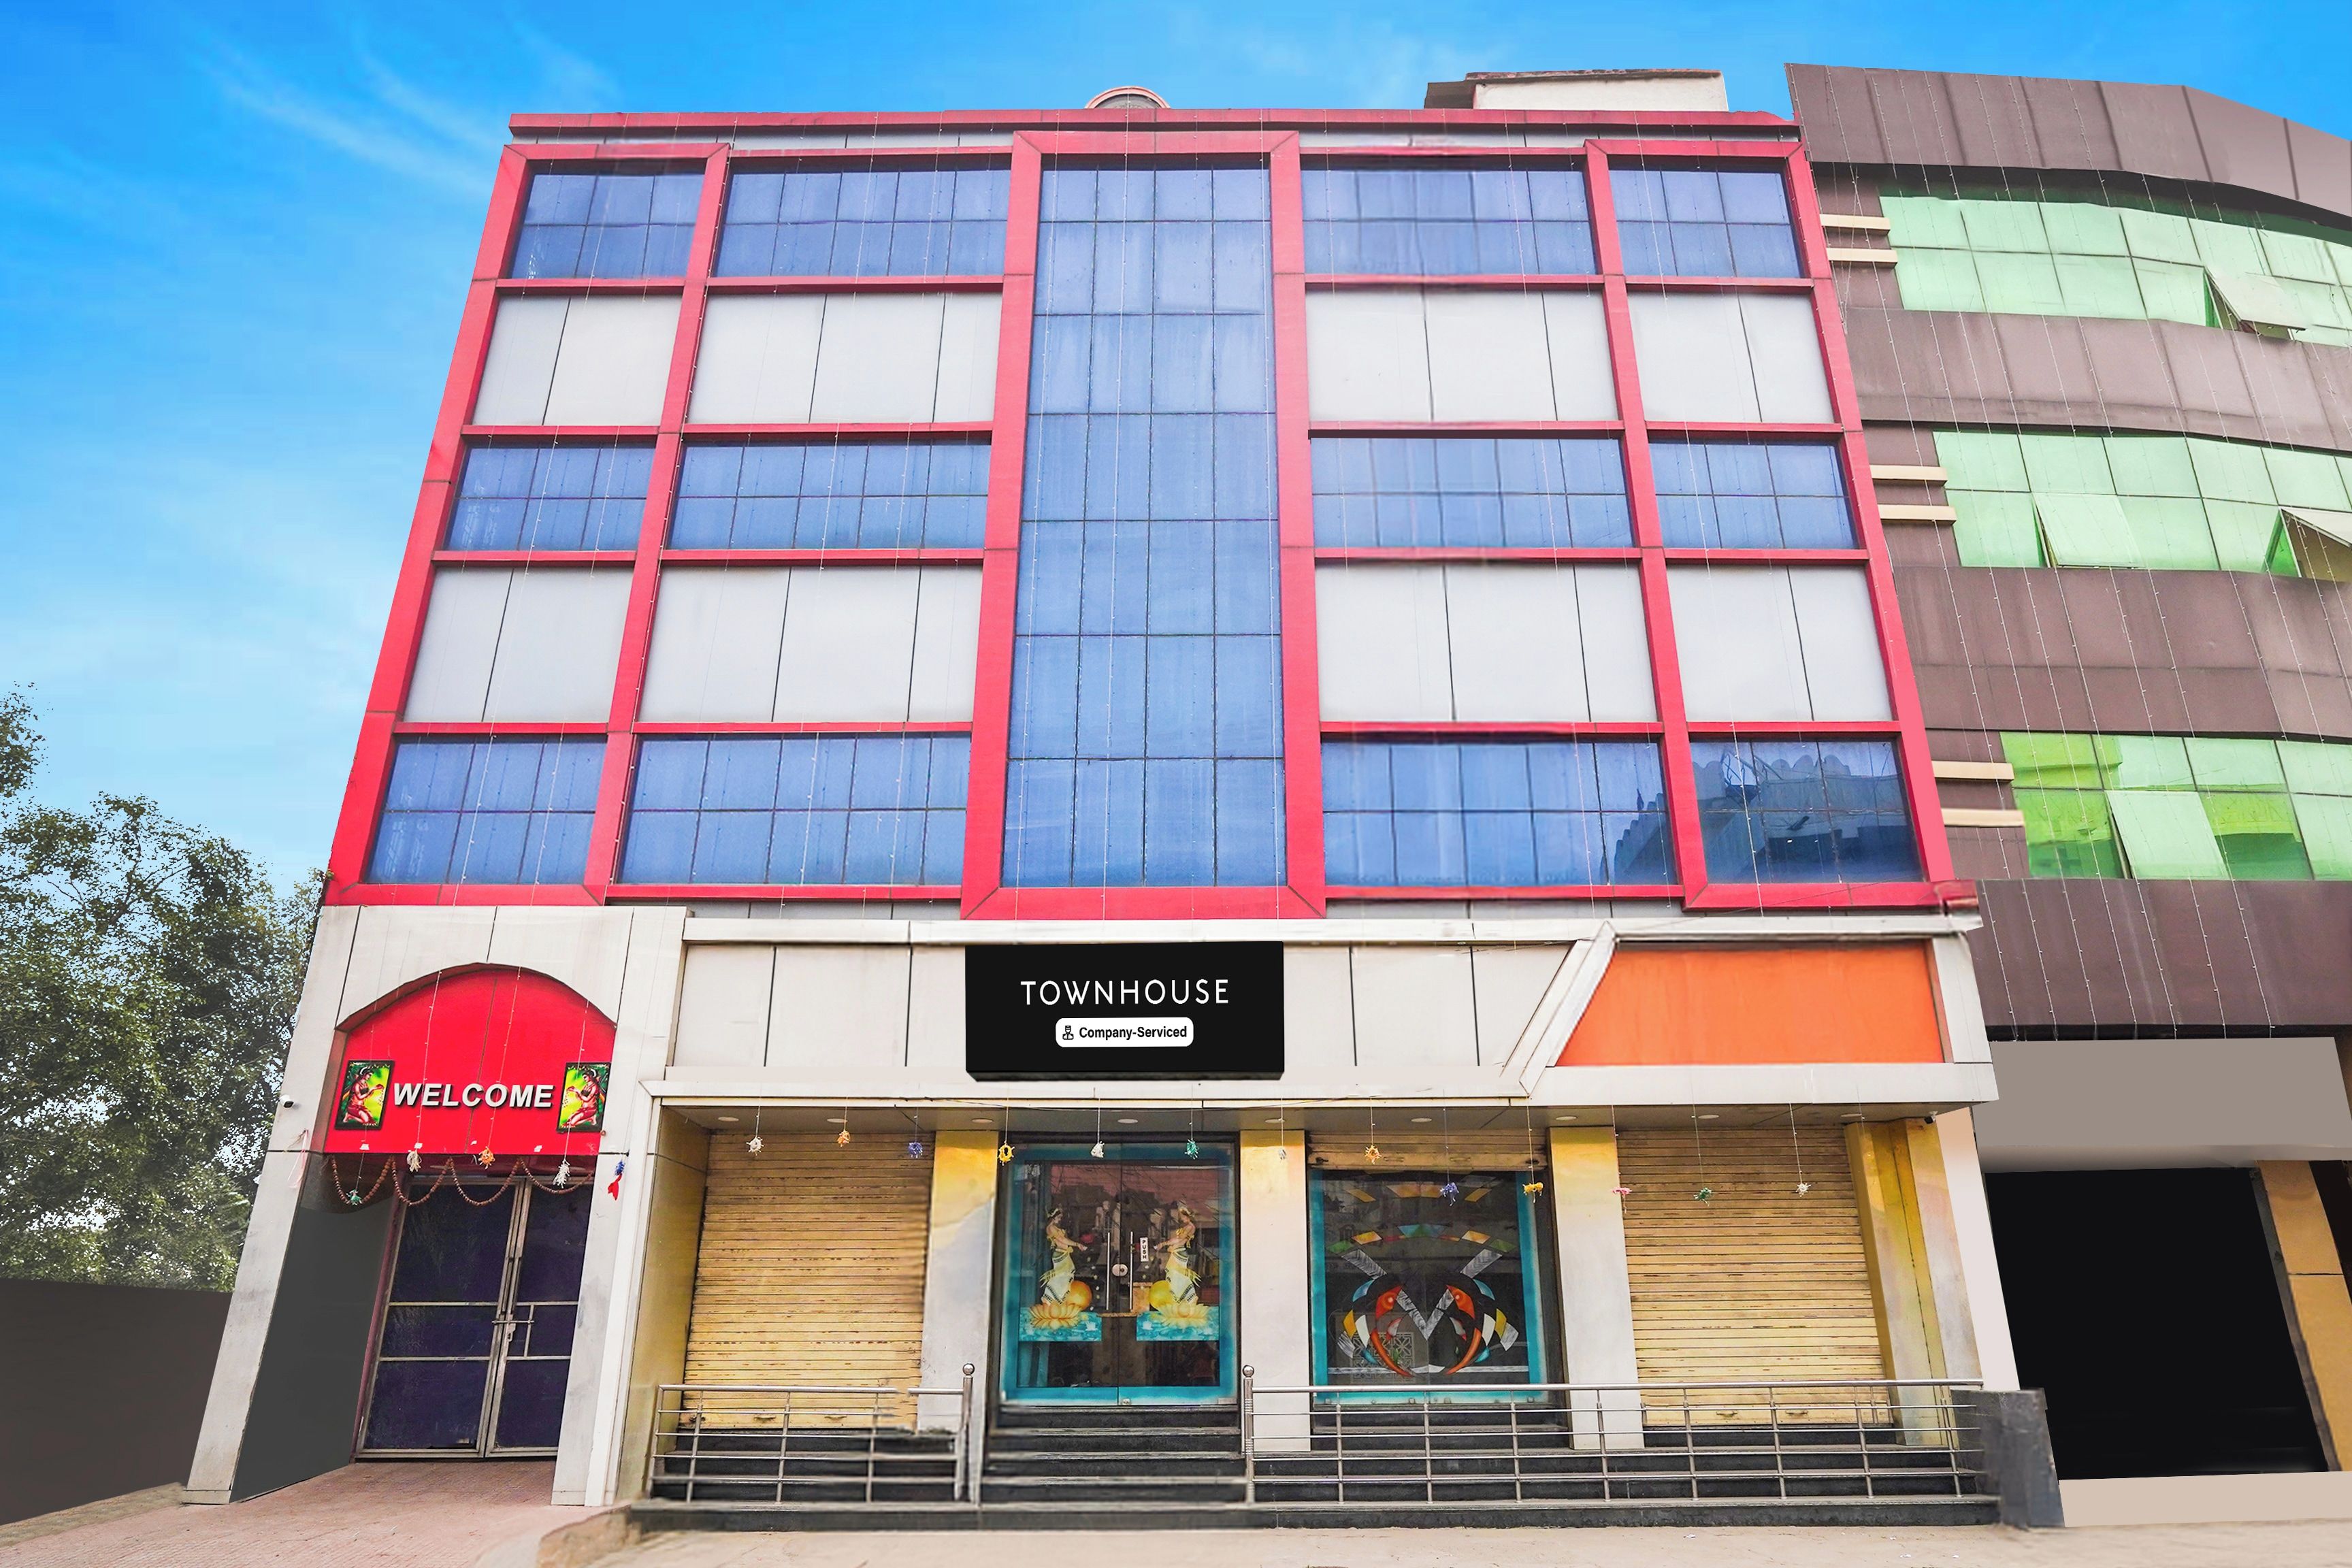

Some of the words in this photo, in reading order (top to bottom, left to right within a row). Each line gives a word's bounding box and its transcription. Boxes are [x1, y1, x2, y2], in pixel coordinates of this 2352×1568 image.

[1021, 979, 1229, 1006] TOWNHOUSE
[1079, 1026, 1187, 1041] Company-Serviced
[393, 1082, 554, 1108] WELCOME
